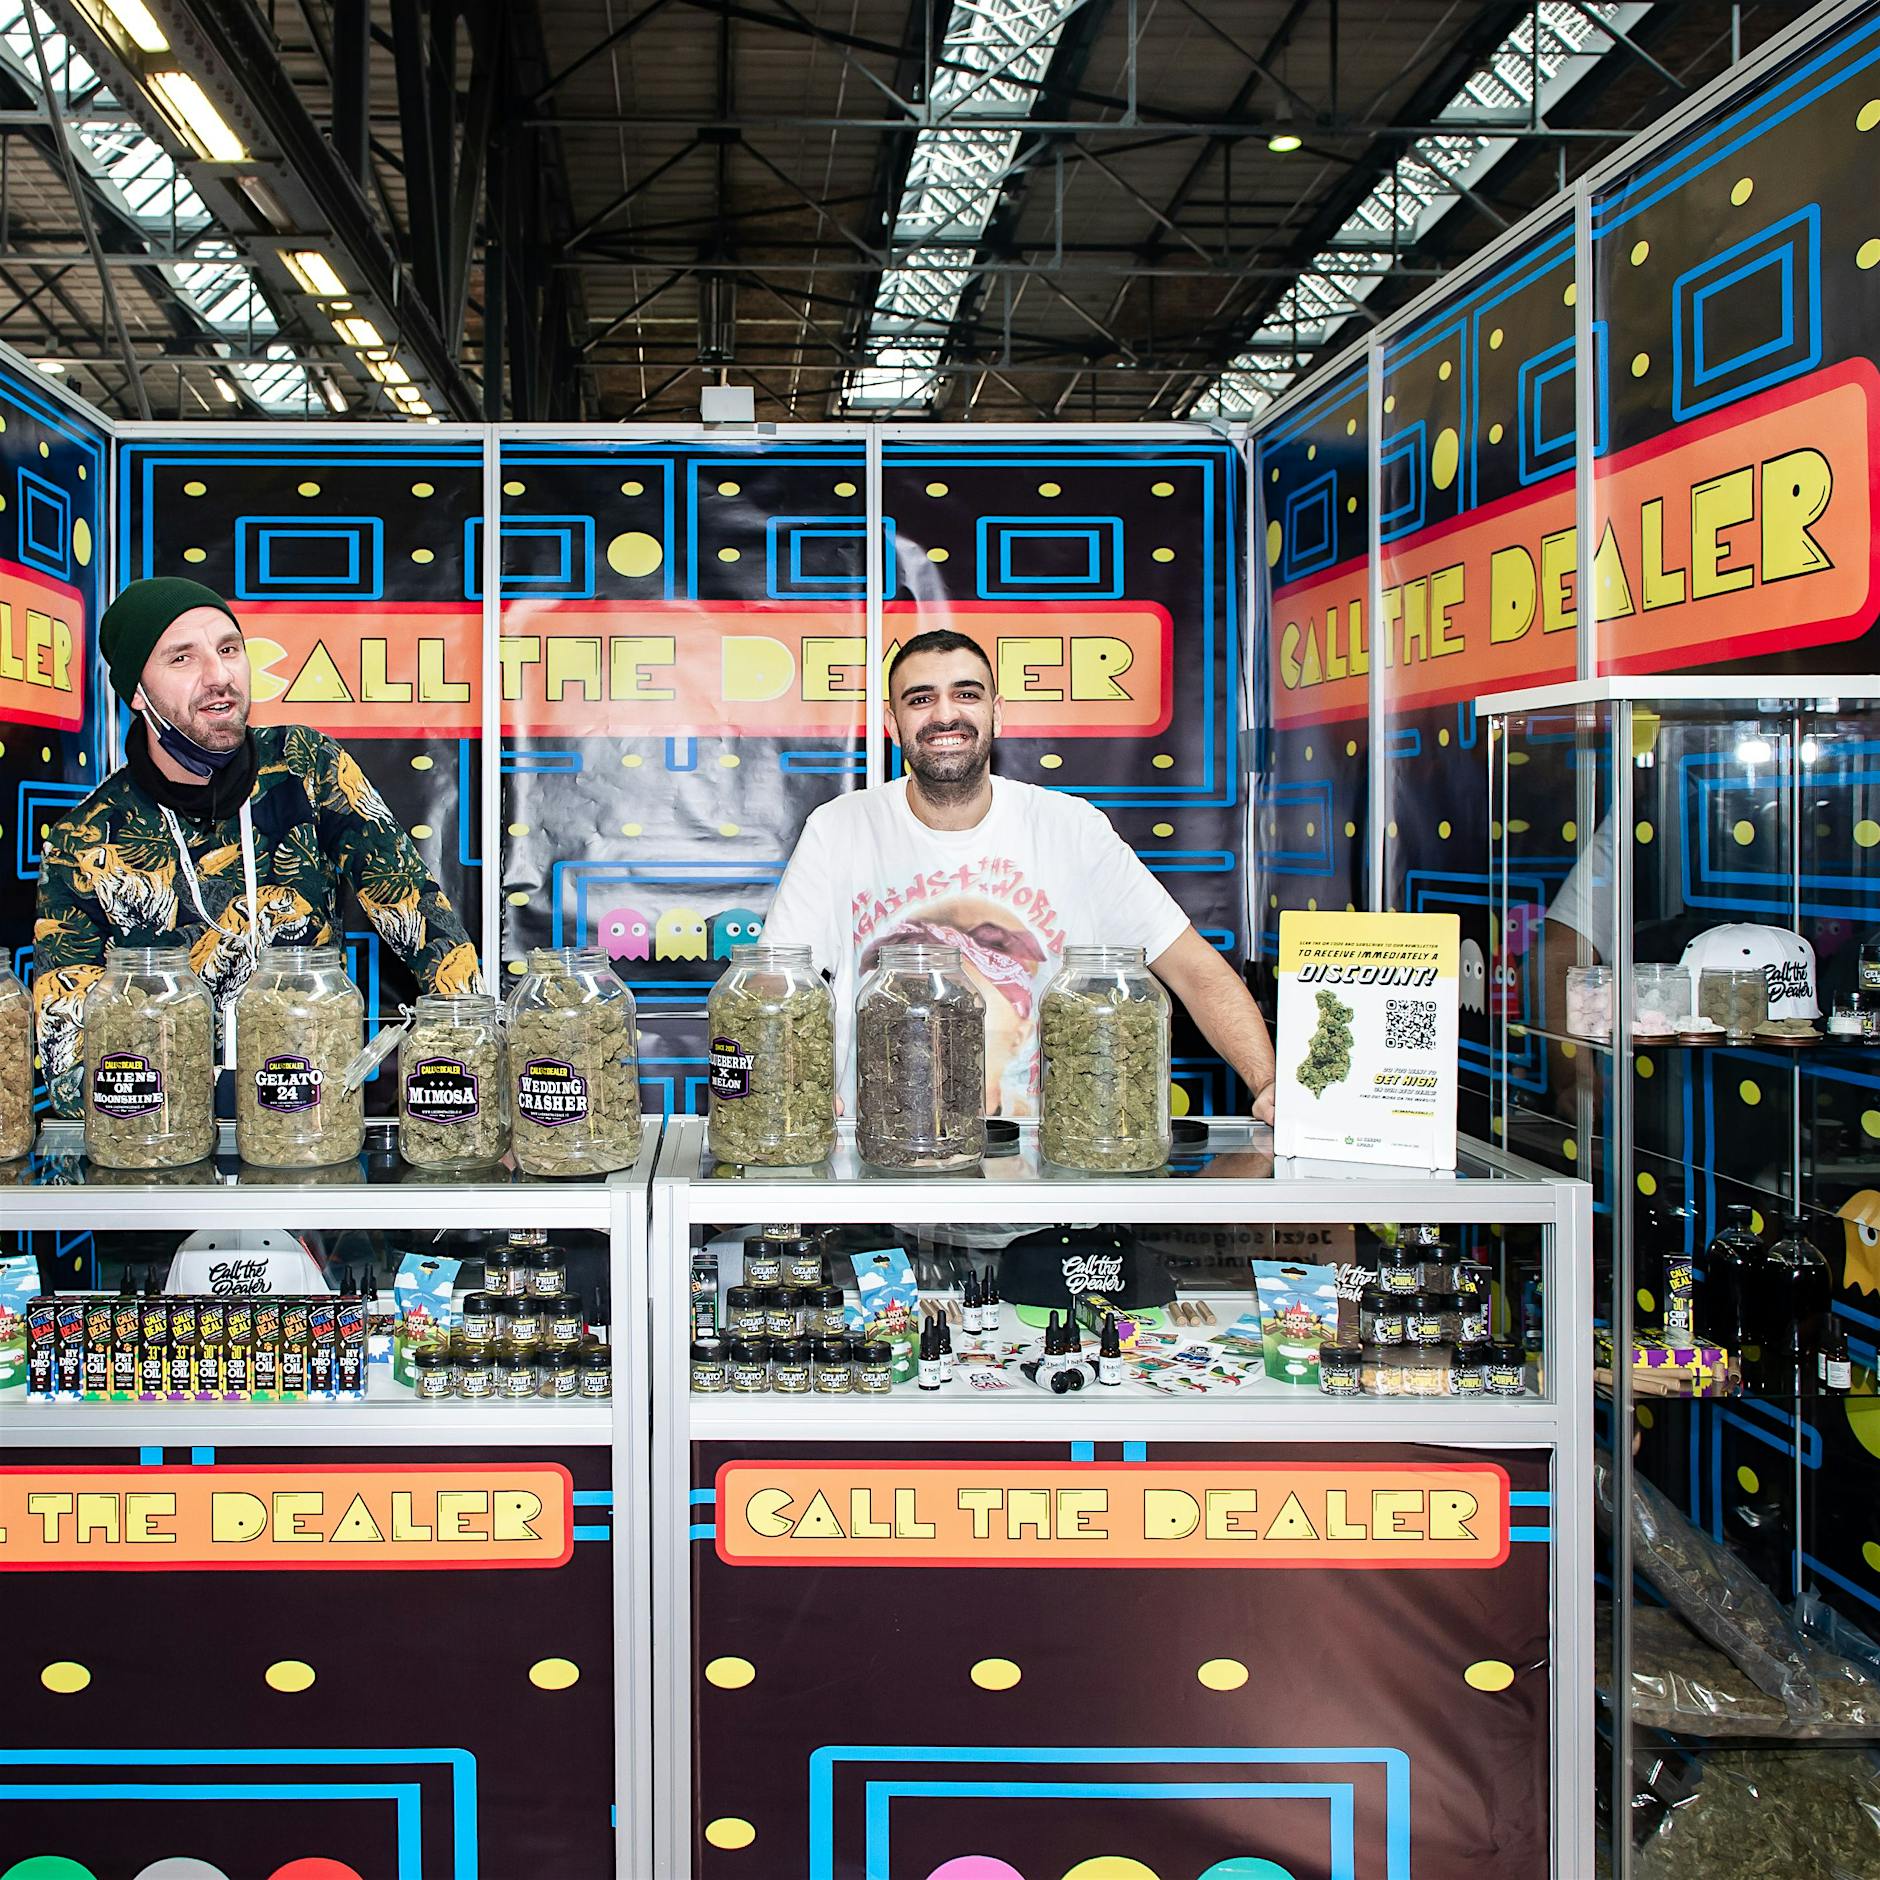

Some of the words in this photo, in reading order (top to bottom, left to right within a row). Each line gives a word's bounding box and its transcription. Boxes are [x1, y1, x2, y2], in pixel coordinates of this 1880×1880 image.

[1280, 598, 1369, 690] CALL
[1382, 561, 1465, 668] THE
[1490, 447, 1835, 645] DEALER
[244, 637, 470, 703] CALL
[500, 636, 676, 702] THE
[721, 636, 1135, 702] DEER
[1299, 949, 1312, 957] TO
[1314, 949, 1356, 958] RECEIVE
[1357, 951, 1429, 960] IMMEDIATELY
[1297, 962, 1439, 987] DISCOUNT!
[97, 1072, 156, 1082] ALIENS
[255, 1069, 323, 1086] GELATO
[1374, 1073, 1401, 1085] GET
[1402, 1075, 1438, 1088] HIGH
[521, 1077, 582, 1095] WEDDING
[712, 1076, 741, 1089] MELON
[114, 1083, 134, 1093] ON
[277, 1086, 298, 1100] 24
[94, 1092, 163, 1103] MOONSHINE
[408, 1087, 477, 1104] MIMOSA
[519, 1092, 588, 1111] CRASHER
[209, 1260, 242, 1282] Call
[240, 1258, 269, 1279] the
[751, 1266, 778, 1275] GELATO
[792, 1266, 819, 1275] GELATO
[1062, 1254, 1098, 1277] Call
[1096, 1254, 1123, 1276] the
[212, 1278, 272, 1295] Dealer
[1065, 1273, 1125, 1295] Dealer
[740, 1317, 765, 1327] GELATO
[1669, 1319, 1688, 1328] OIL
[512, 1324, 535, 1334] FRUIT
[553, 1324, 577, 1335] FRUIT
[37, 1351, 50, 1359] HY
[66, 1349, 78, 1357] HY
[87, 1353, 105, 1362] PET
[115, 1353, 133, 1362] PET
[256, 1351, 274, 1361] PET
[284, 1353, 302, 1363] PET
[318, 1349, 330, 1357] HY
[346, 1349, 358, 1357] HY
[31, 1359, 50, 1368] DRO
[59, 1357, 78, 1366] DRO
[143, 1360, 160, 1368] CBD
[172, 1360, 189, 1368] CBD
[200, 1360, 217, 1368] CBD
[228, 1360, 245, 1368] CBD
[256, 1361, 275, 1372] OIL
[312, 1358, 330, 1366] DRO
[340, 1358, 358, 1366] DRO
[36, 1368, 46, 1376] PS
[64, 1366, 75, 1374] PS
[87, 1362, 106, 1373] OIL
[115, 1362, 134, 1373] OIL
[200, 1368, 217, 1377] OIL
[283, 1363, 302, 1374] OIL
[316, 1366, 326, 1374] PS
[345, 1366, 355, 1374] PS
[143, 1368, 161, 1378] OIL
[172, 1368, 189, 1378] OIL
[228, 1368, 245, 1378] OIL
[693, 1372, 720, 1380] GELATO
[734, 1372, 761, 1381] GELATO
[778, 1373, 805, 1381] GELATO
[821, 1373, 848, 1382] GELATO
[862, 1373, 889, 1381] GELATO
[424, 1376, 448, 1387] FRUIT
[464, 1376, 488, 1387] FRUIT
[508, 1376, 531, 1387] FRUIT
[585, 1376, 609, 1387] FRUIT
[28, 1492, 176, 1543] THE
[212, 1490, 543, 1543] DEALER
[745, 1488, 936, 1539] CALL
[958, 1488, 1109, 1539] THE
[1143, 1488, 1480, 1541] DEALER
